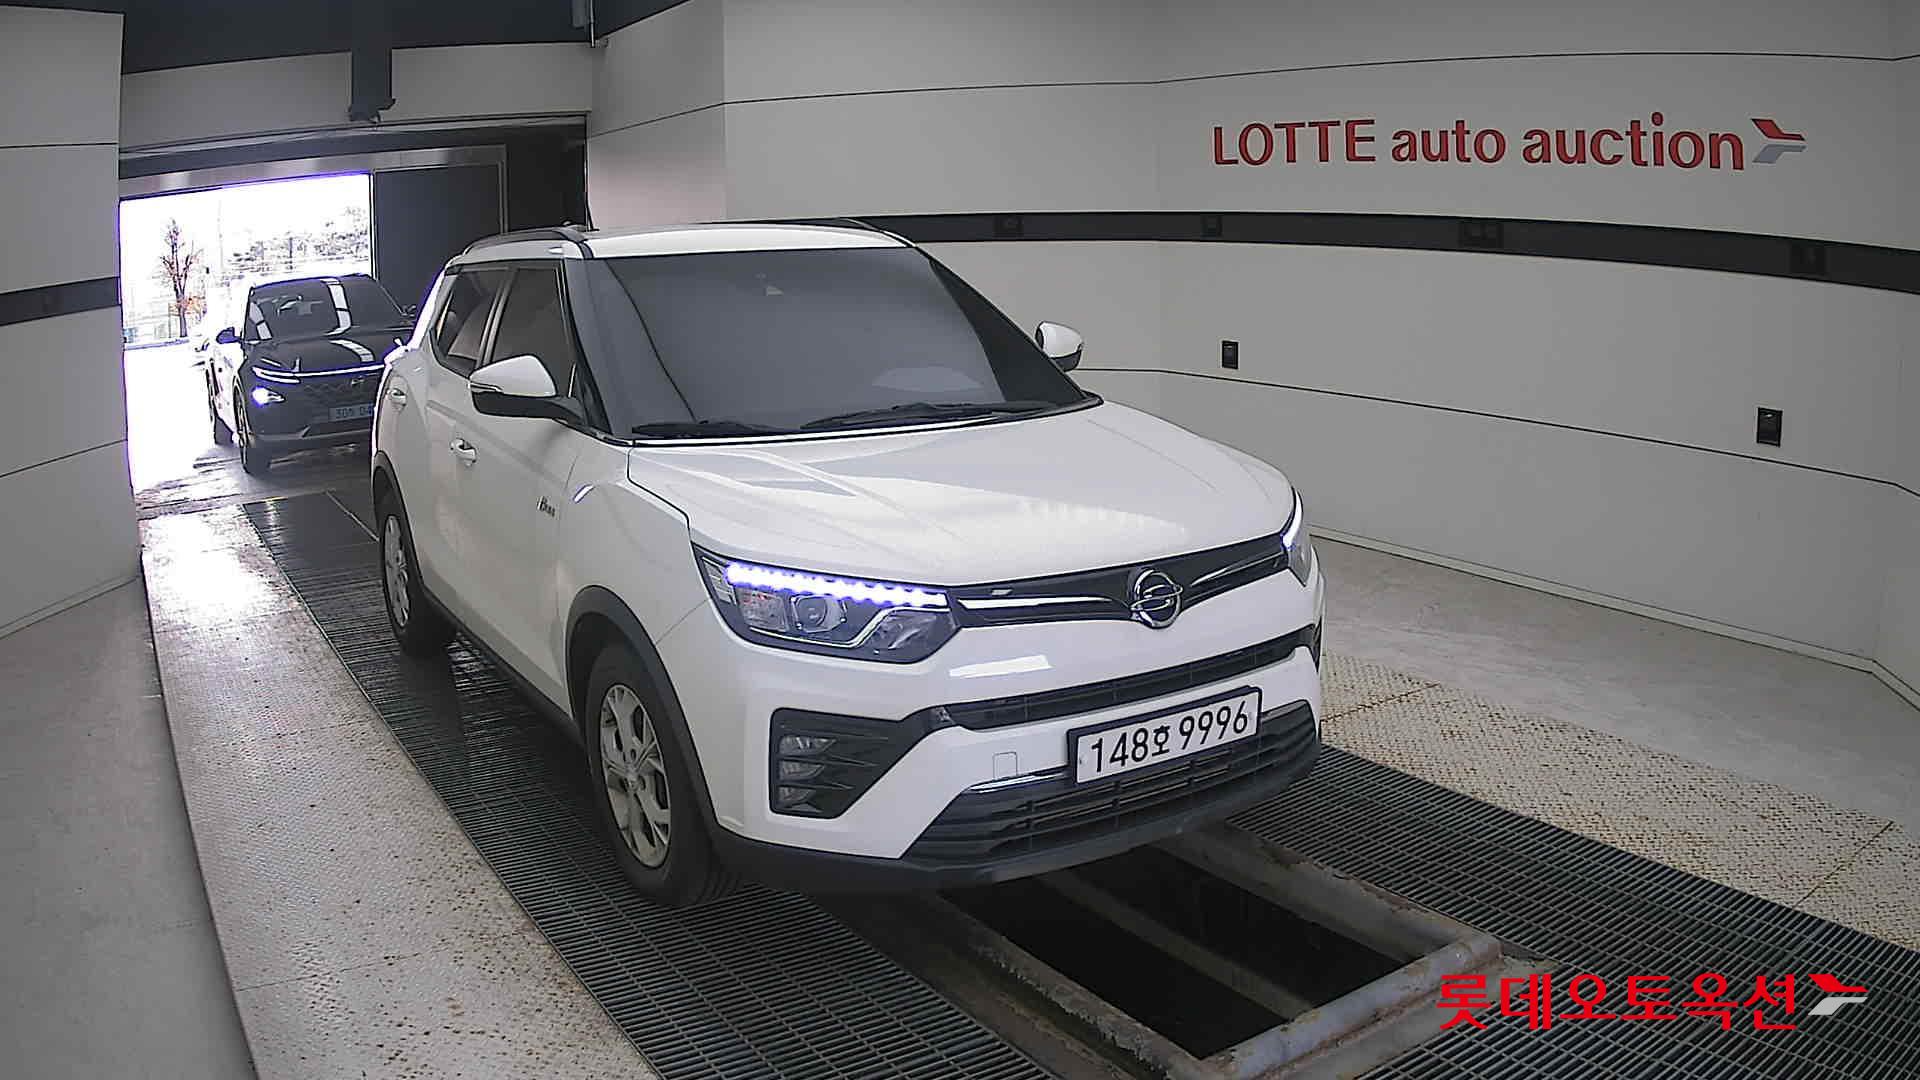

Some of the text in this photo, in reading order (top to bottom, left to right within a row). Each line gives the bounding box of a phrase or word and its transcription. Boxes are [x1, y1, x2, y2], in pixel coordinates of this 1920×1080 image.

[1214, 111, 1744, 170] LOTTE auto auction
[1091, 700, 1248, 773] 148호 9996
